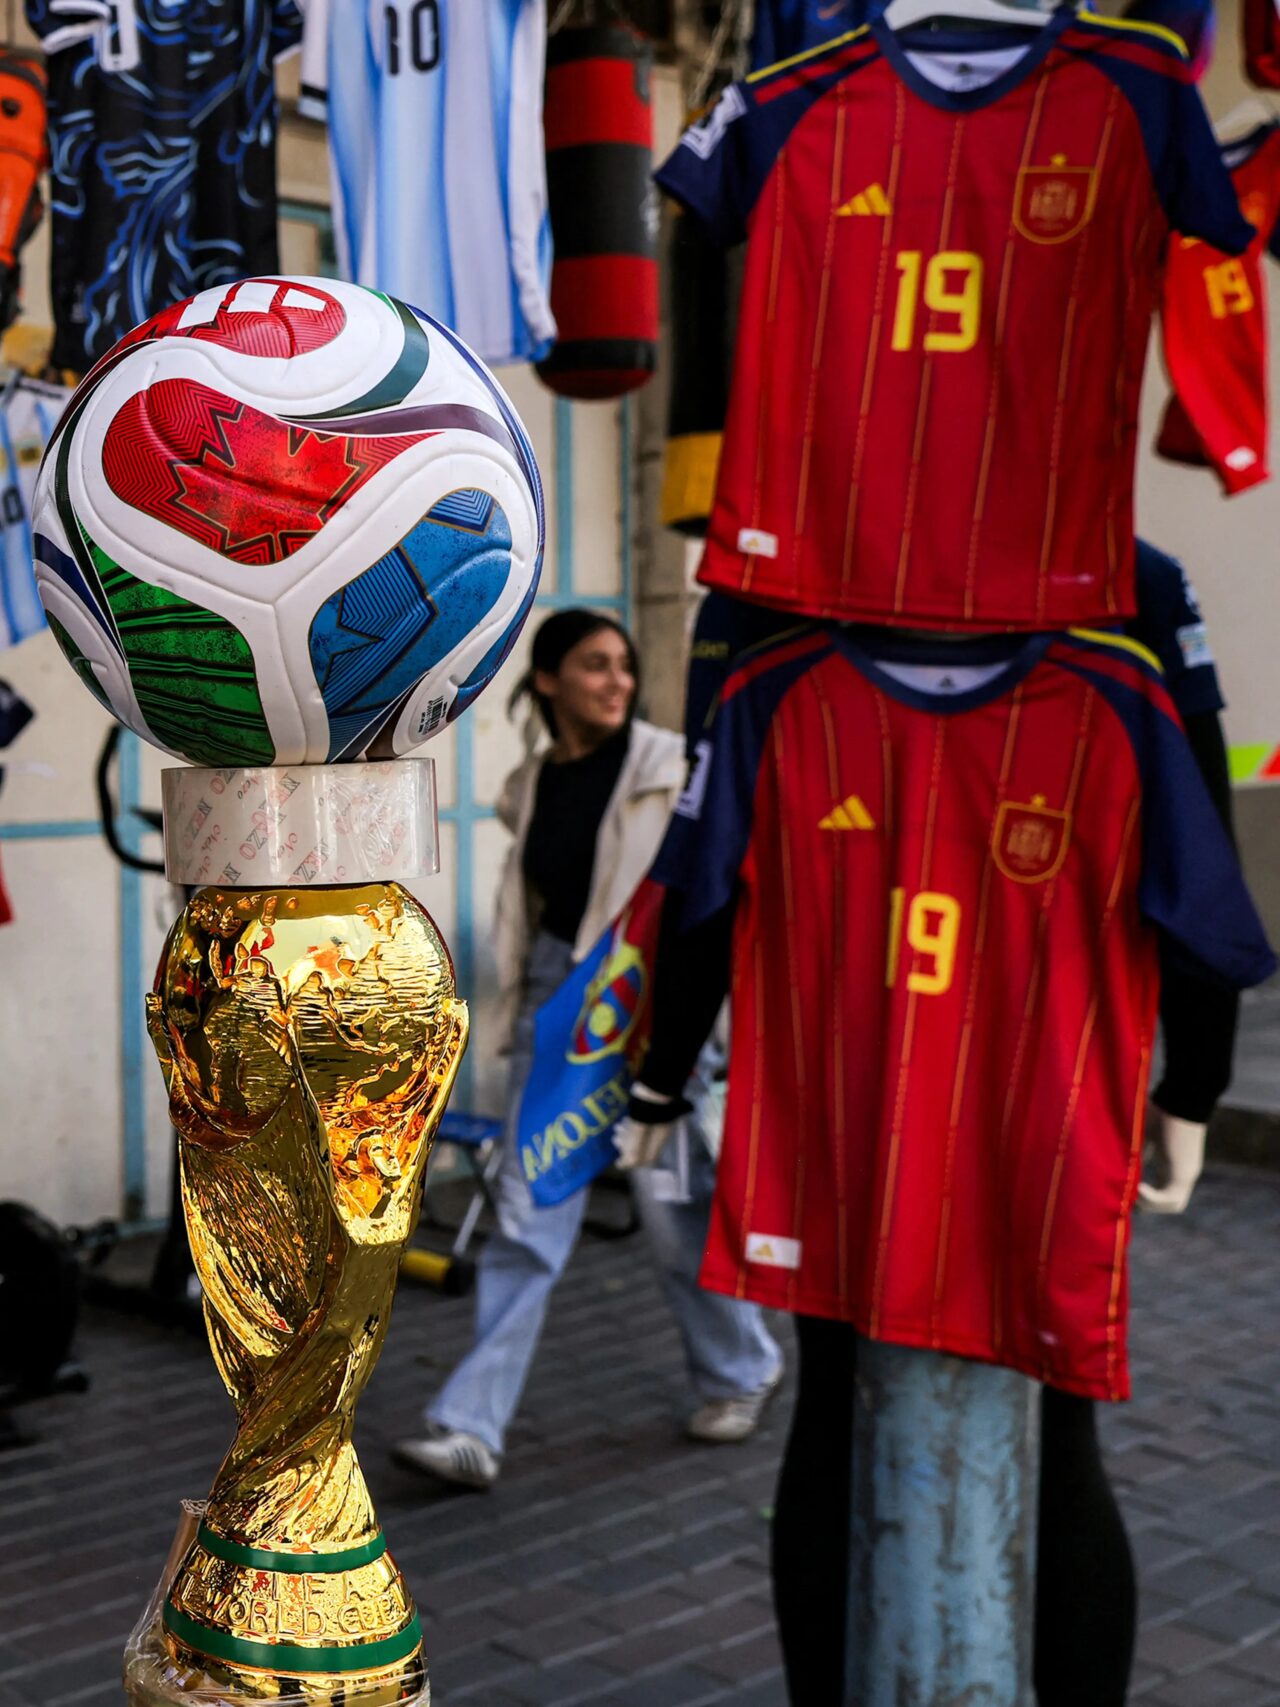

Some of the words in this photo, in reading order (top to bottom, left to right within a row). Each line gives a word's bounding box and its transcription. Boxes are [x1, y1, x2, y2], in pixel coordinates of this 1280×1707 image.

[385, 0, 440, 76] 10
[891, 250, 984, 353] 19
[1202, 259, 1255, 319] 19
[885, 887, 962, 996] 19
